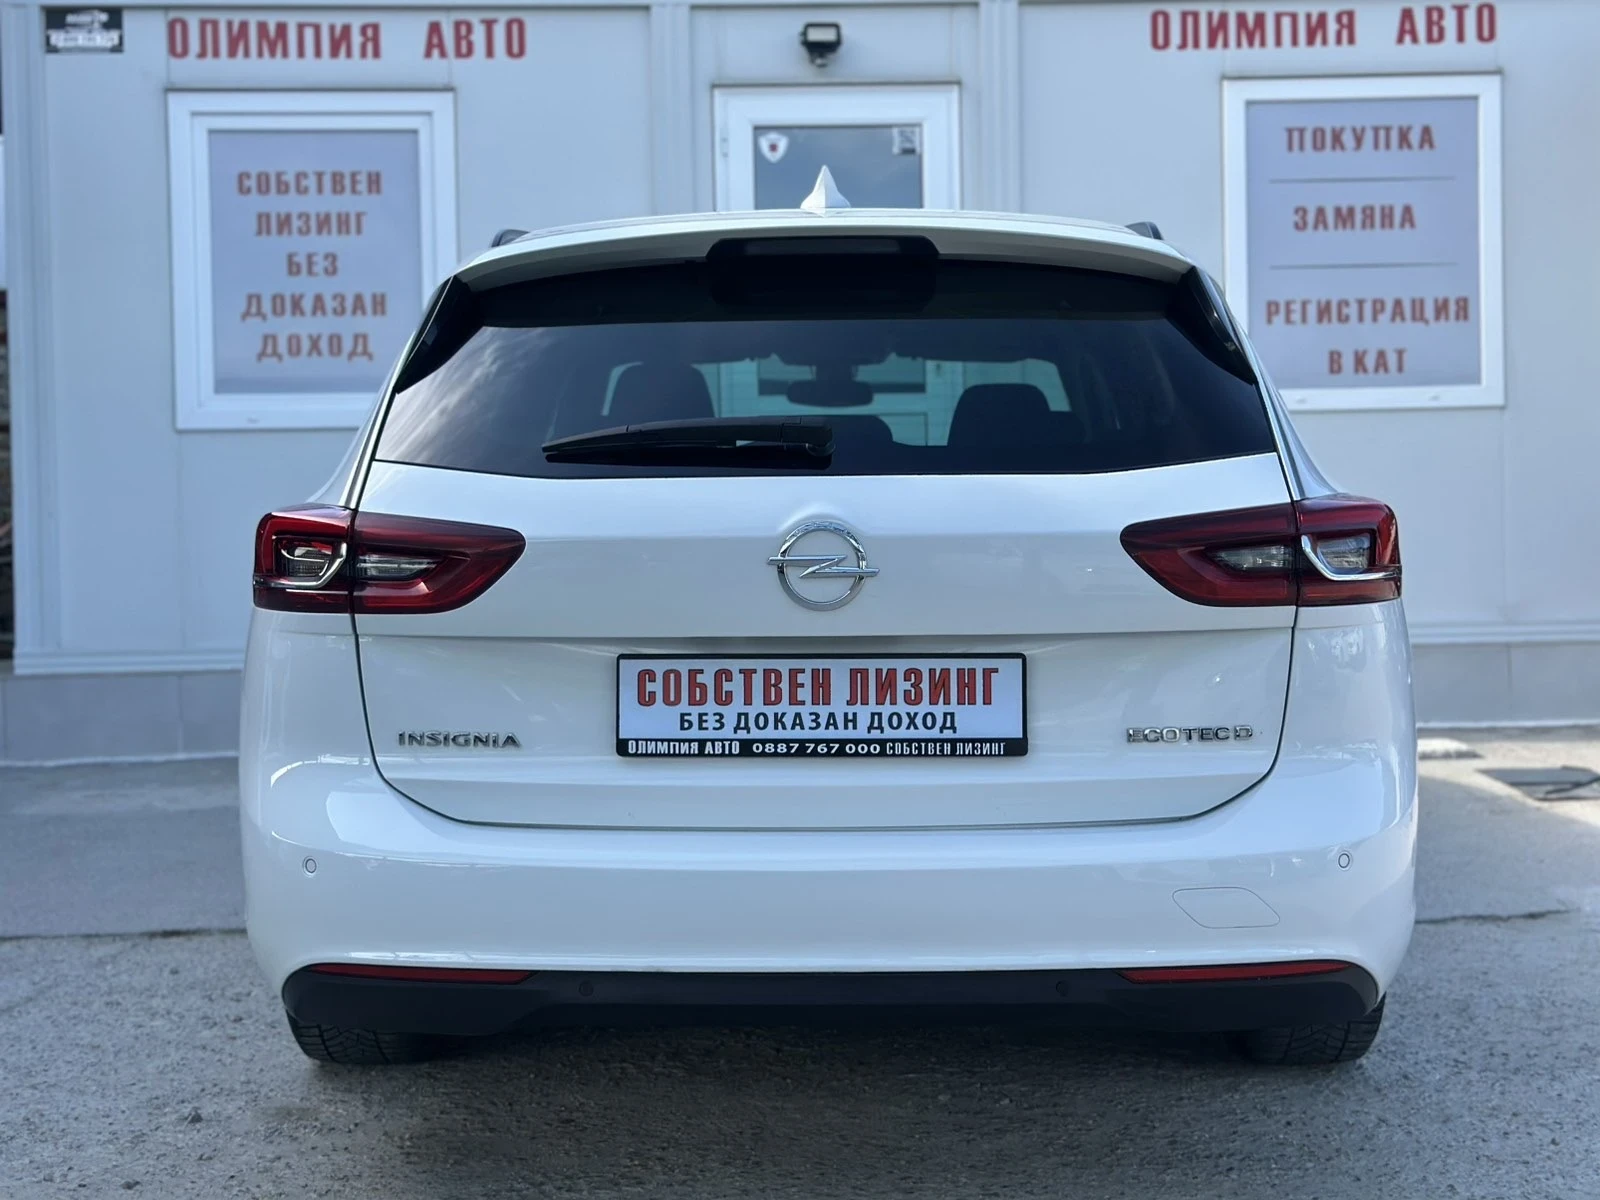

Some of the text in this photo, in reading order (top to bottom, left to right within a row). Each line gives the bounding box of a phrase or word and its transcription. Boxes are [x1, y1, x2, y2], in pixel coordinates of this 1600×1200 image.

[167, 18, 382, 59] ОЛИМПИЯ
[424, 18, 527, 59] АВТО
[1150, 3, 1497, 50] ОЛИМПИЯ АВТО
[1285, 125, 1436, 153] ПОКУПКА
[237, 170, 382, 196] СОБСТВЕН
[255, 211, 368, 237] ЛИЗИНГ
[1293, 204, 1417, 232] ЗАМЯНА
[286, 252, 339, 278] БЕЗ
[240, 292, 388, 323] ДОКАЗАН
[1266, 296, 1470, 326] РЕГИСТРАЦИЯ
[256, 333, 374, 363] ДОХОД
[1328, 348, 1407, 375] В КАТ
[637, 667, 999, 706] СОБСТВЕН ЛИЗИНГ
[679, 711, 958, 735] БЕЗ ДОКАЗАН ДОХОД
[398, 731, 521, 748] INSIGNIA
[628, 740, 1006, 755] ОЛИМПИЯ АВТО 0887 767 000 СОБСТВЕН ЛИЗИНГ
